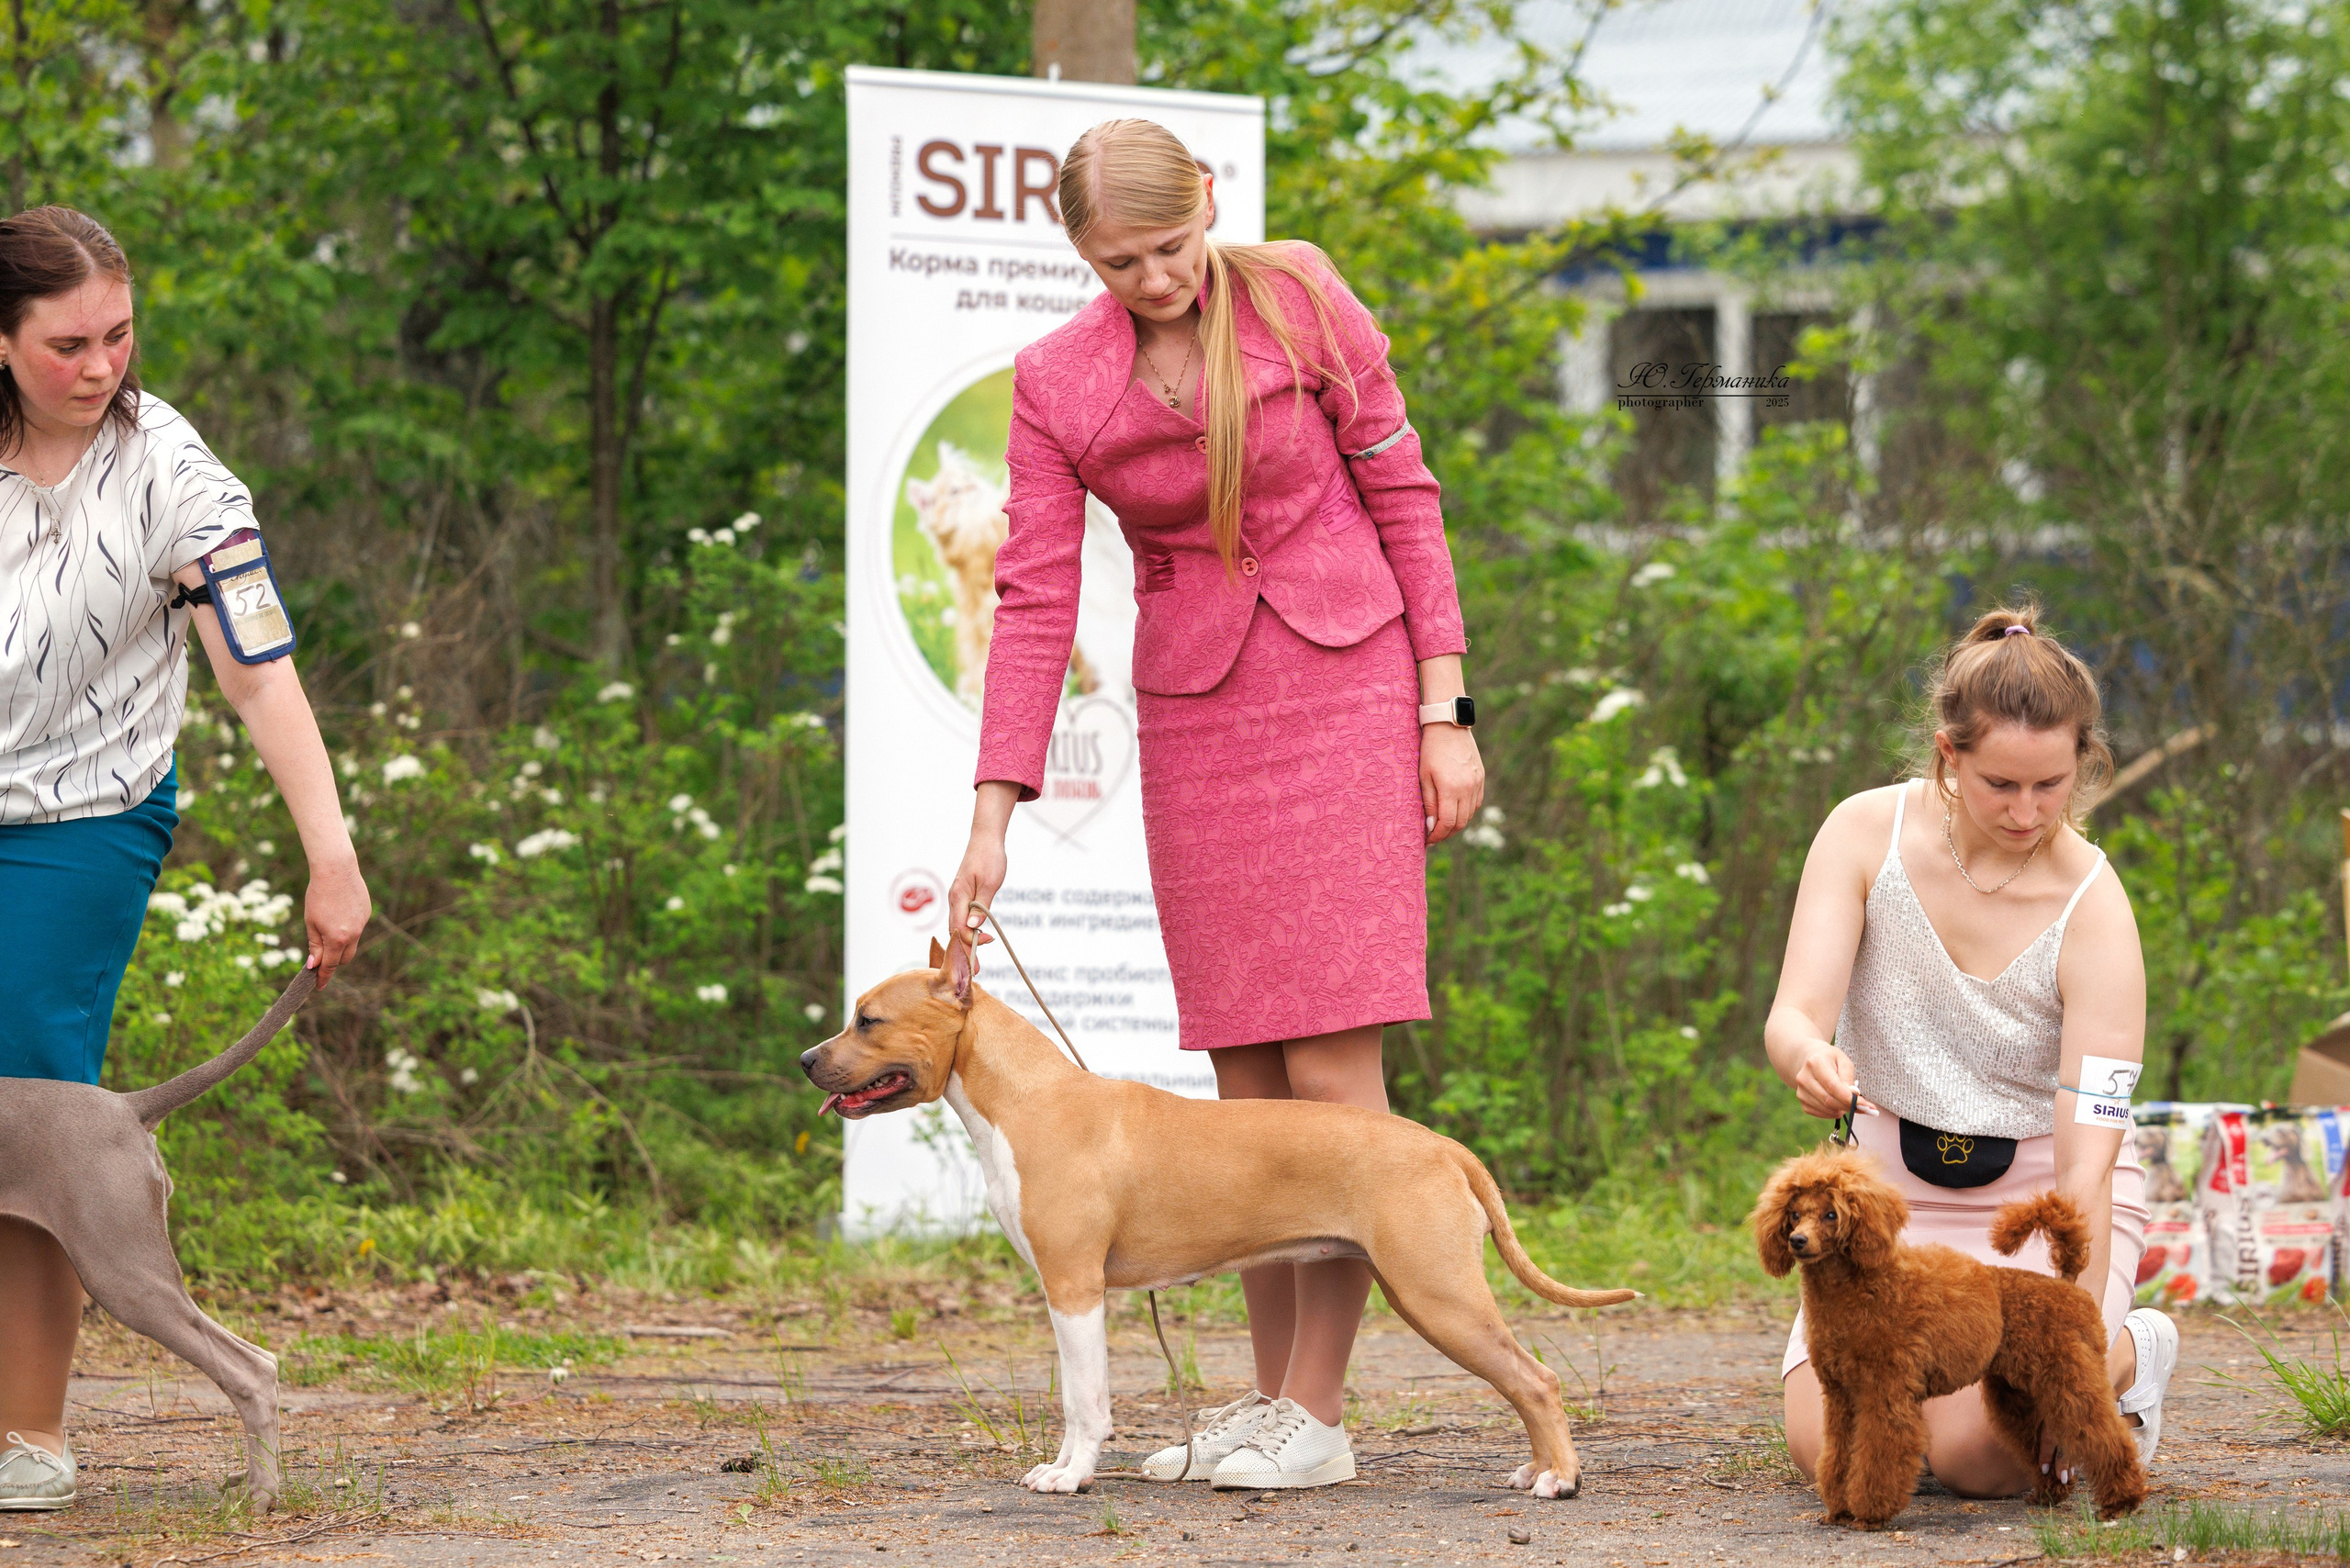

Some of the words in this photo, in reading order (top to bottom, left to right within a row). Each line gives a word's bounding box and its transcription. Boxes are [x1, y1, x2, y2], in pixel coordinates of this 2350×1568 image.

[889, 248, 979, 278] Корма
[988, 256, 1098, 287] премиу
[956, 288, 1008, 312] для
[233, 583, 271, 617] 52
[2093, 1103, 2129, 1119] SIRIUS
